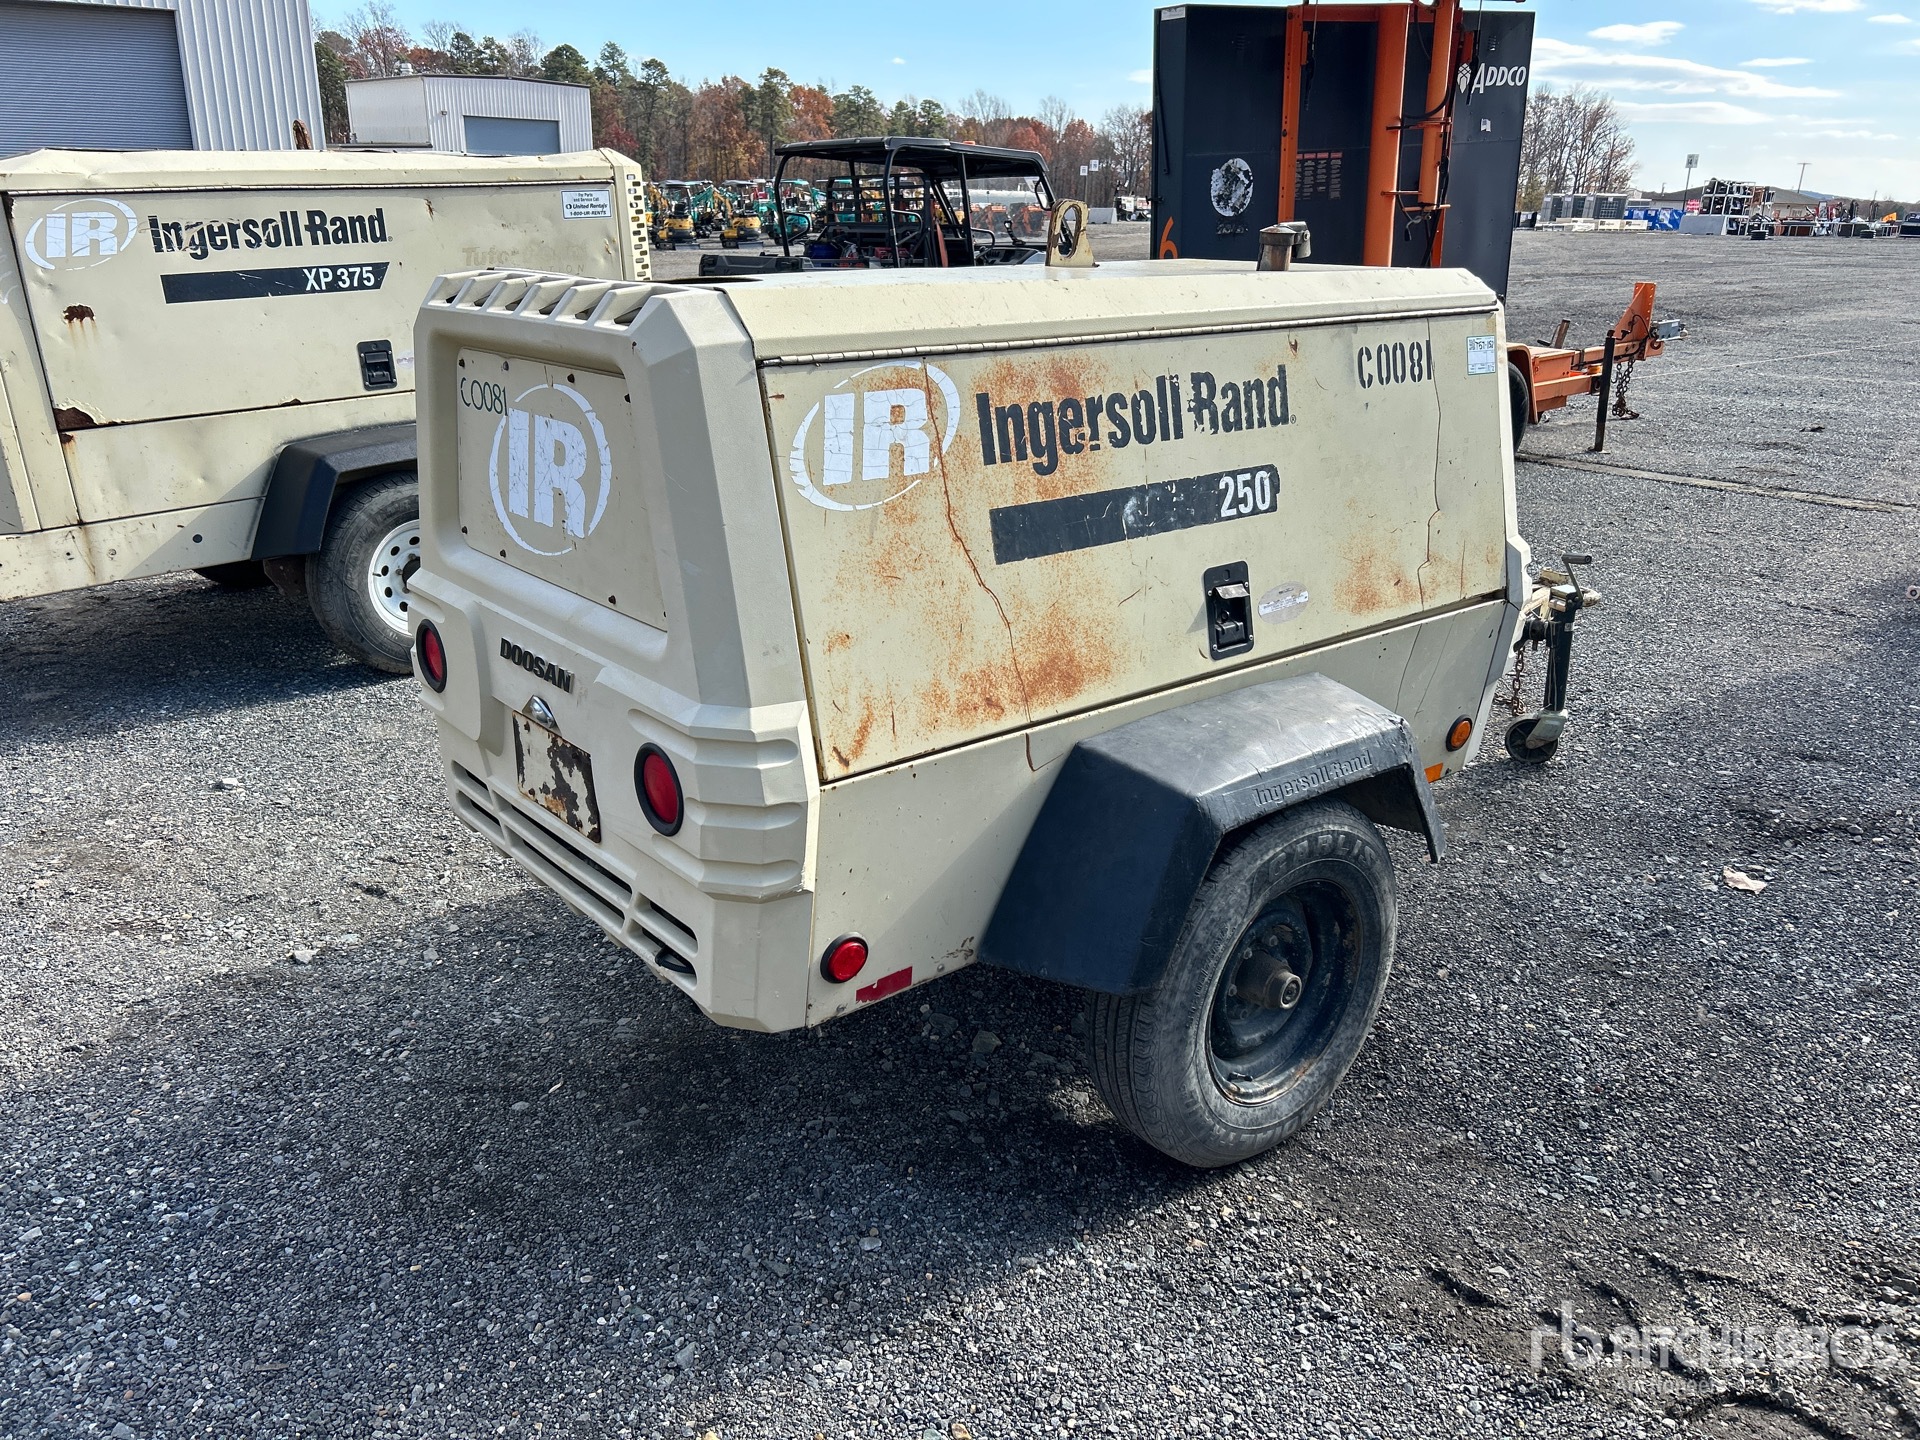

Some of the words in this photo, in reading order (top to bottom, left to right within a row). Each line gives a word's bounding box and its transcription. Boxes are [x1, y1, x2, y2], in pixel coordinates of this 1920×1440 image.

[1471, 63, 1526, 93] ADDCO
[46, 211, 118, 258] IR
[303, 268, 333, 291] XP
[338, 266, 375, 289] 375
[823, 387, 931, 486] IR
[508, 407, 587, 539] IR
[1218, 470, 1272, 518] 250
[500, 636, 574, 694] DOOSAN
